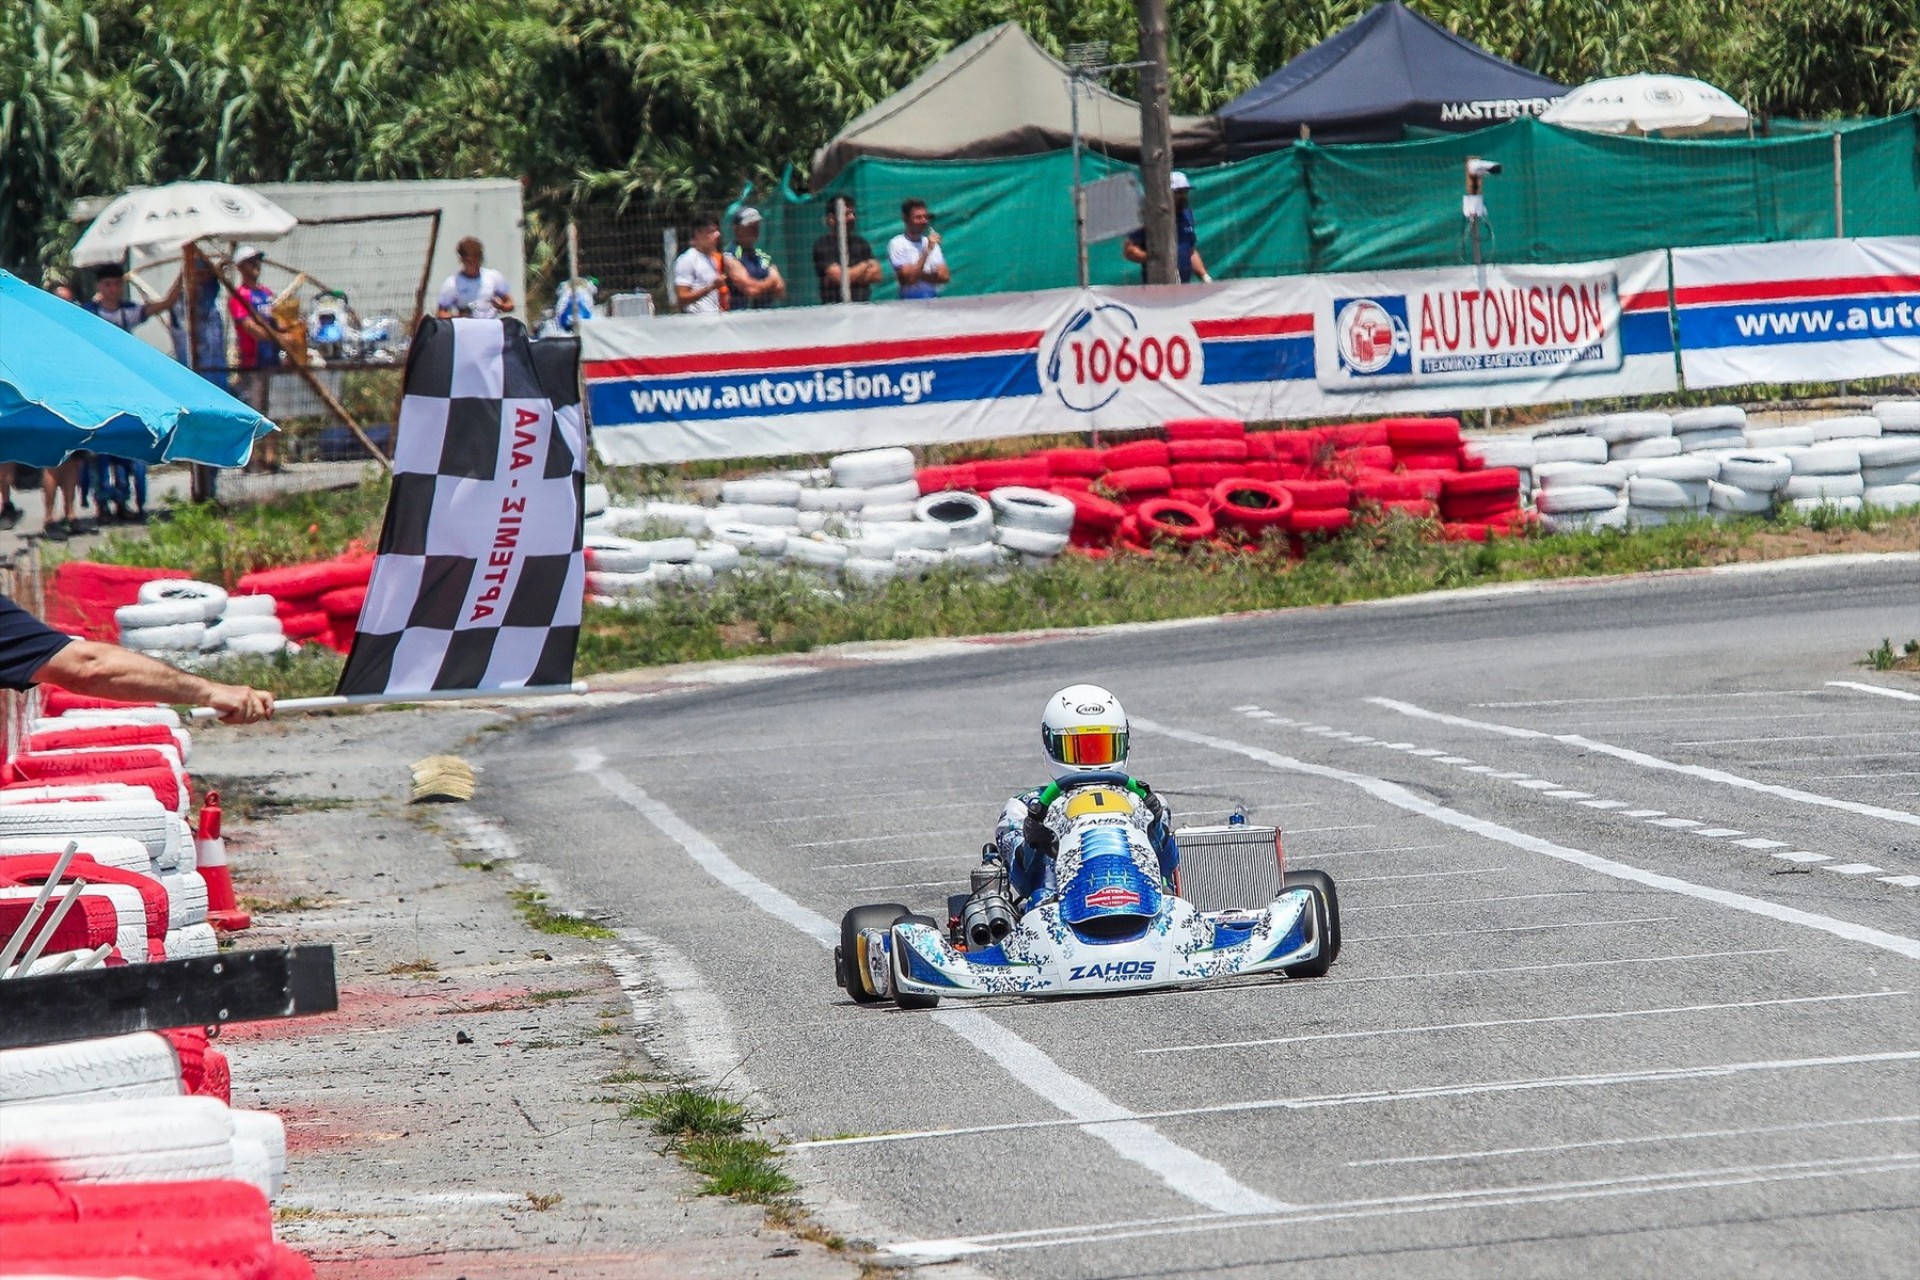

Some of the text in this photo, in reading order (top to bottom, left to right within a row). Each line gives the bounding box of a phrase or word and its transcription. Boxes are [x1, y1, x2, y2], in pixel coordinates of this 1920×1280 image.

[1420, 281, 1605, 352] AUTOVISION
[1072, 335, 1191, 384] 10600
[630, 369, 936, 414] www.autovision.gr
[1089, 792, 1104, 806] 1
[1069, 961, 1156, 981] ZAHOS
[1105, 974, 1153, 983] KARTING
